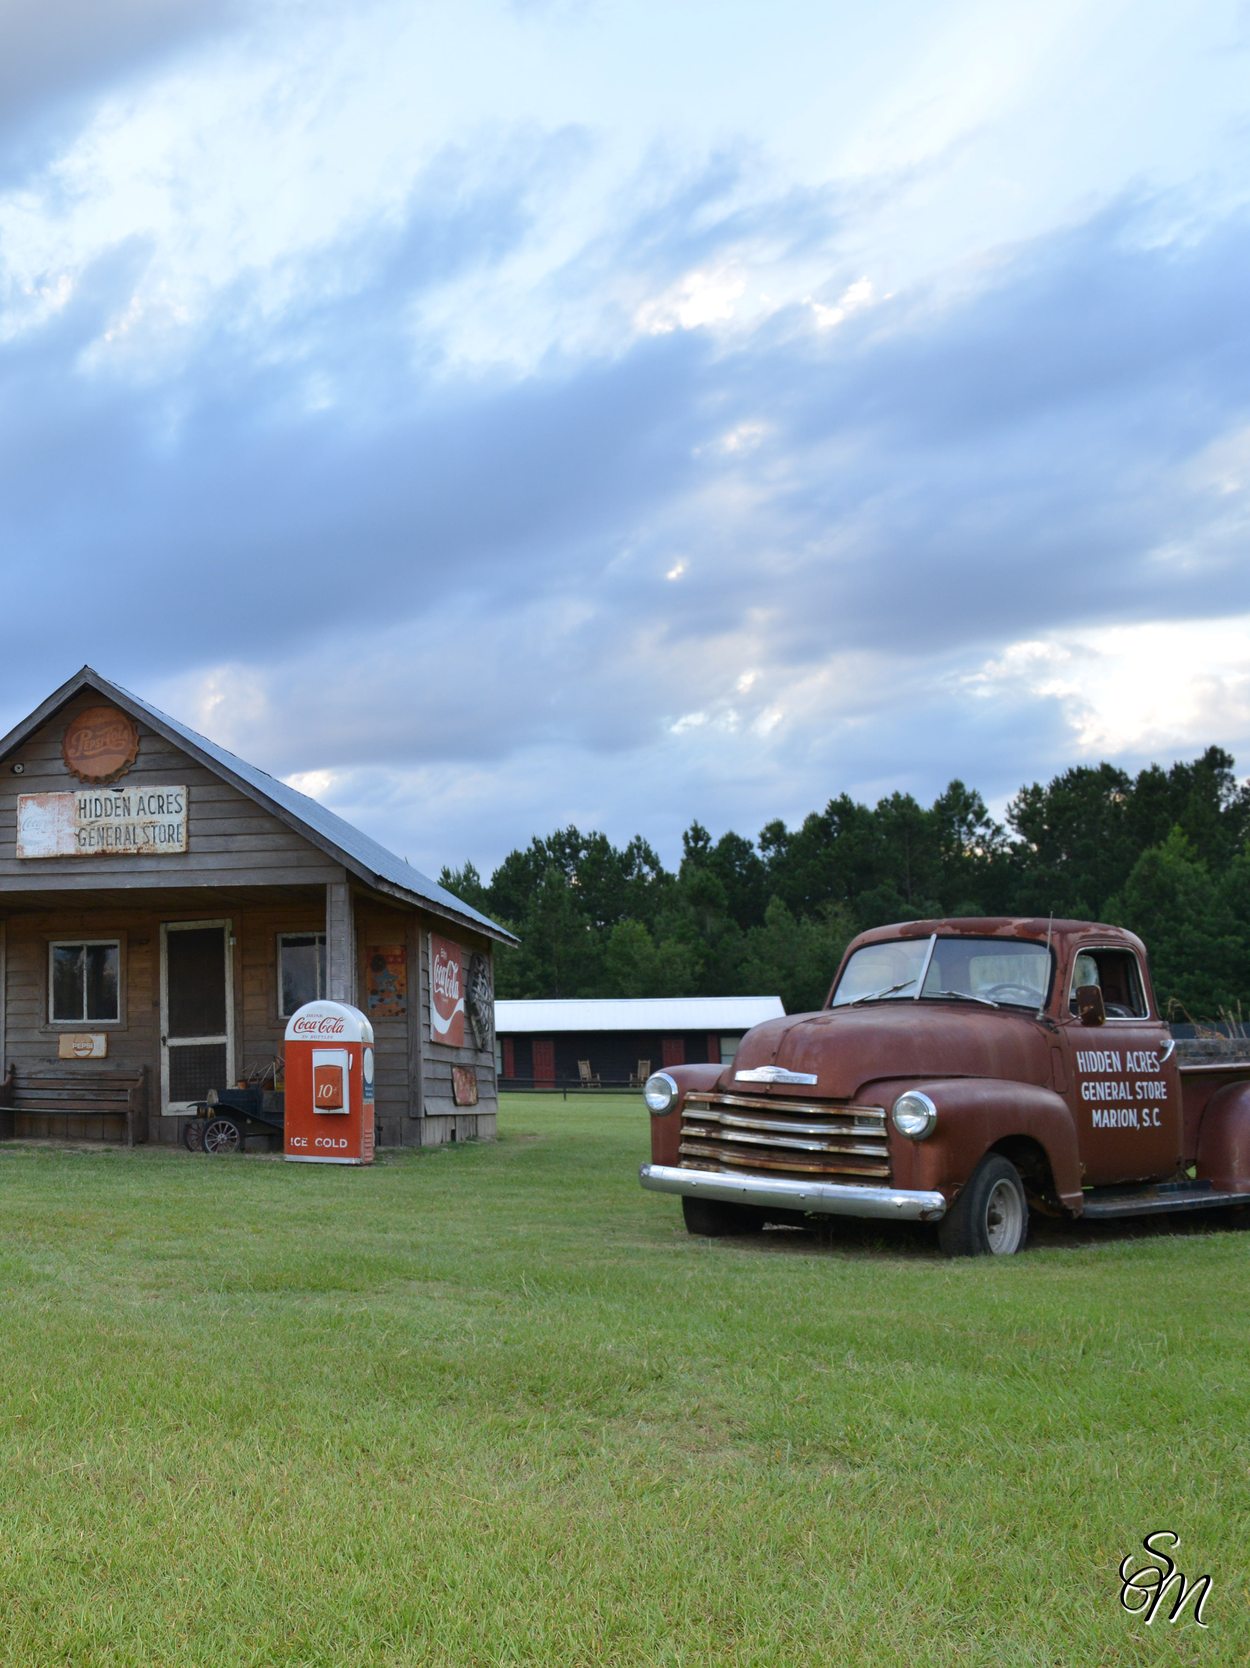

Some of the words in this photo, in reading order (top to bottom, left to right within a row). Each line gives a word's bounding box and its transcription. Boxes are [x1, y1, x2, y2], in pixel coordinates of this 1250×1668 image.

[78, 796, 130, 819] HIDDEN
[136, 793, 183, 816] ACRES
[77, 826, 139, 847] GENERAL
[142, 823, 183, 845] STORE
[1076, 1051, 1122, 1072] HIDDEN
[1126, 1051, 1161, 1072] ACRES
[1081, 1082, 1133, 1100] GENERAL
[1135, 1081, 1167, 1100] STORE
[1092, 1108, 1141, 1131] MARION,
[290, 1137, 308, 1147] ICE
[314, 1138, 348, 1148] COLD
